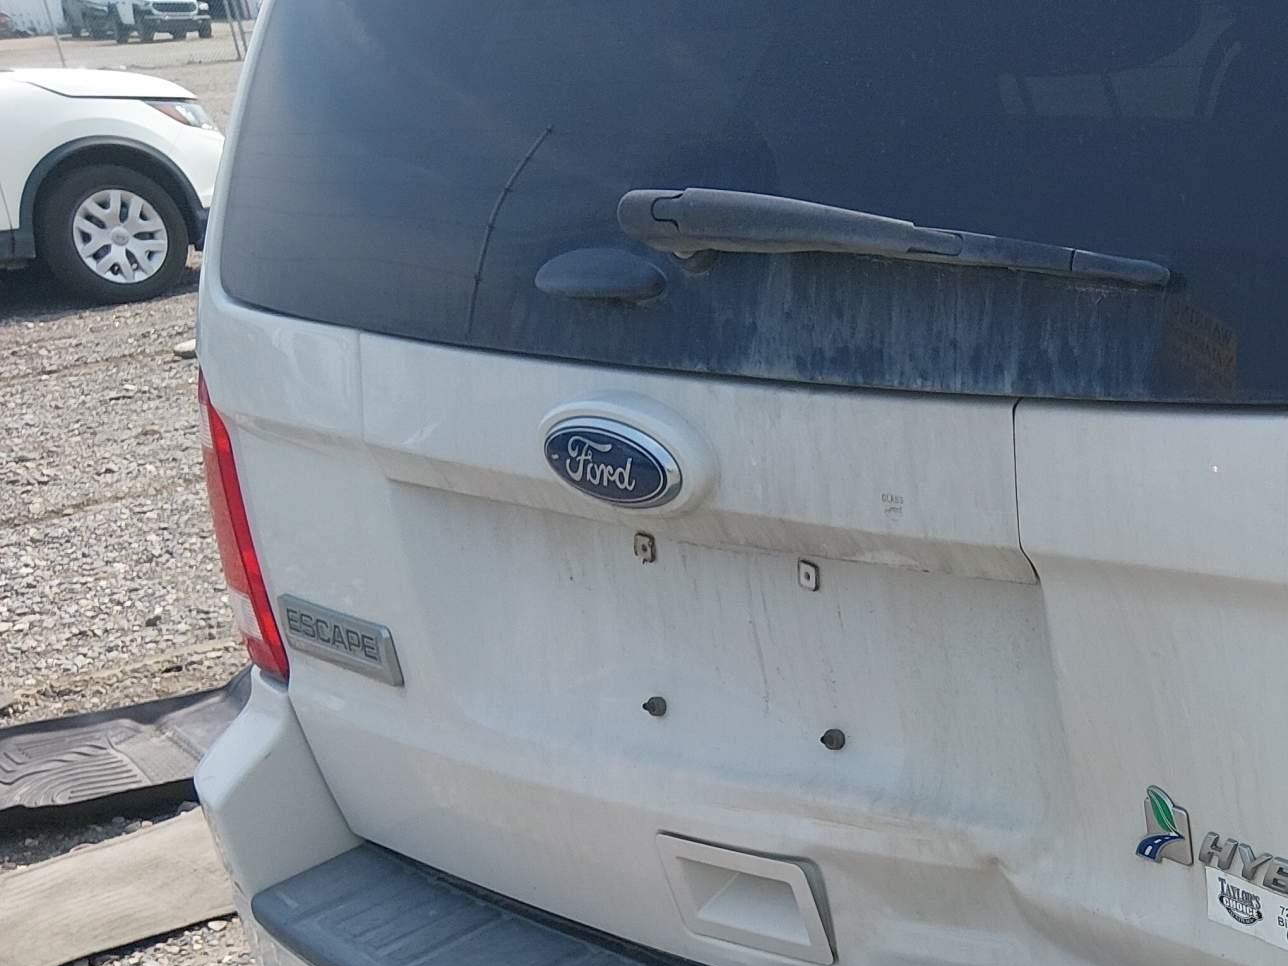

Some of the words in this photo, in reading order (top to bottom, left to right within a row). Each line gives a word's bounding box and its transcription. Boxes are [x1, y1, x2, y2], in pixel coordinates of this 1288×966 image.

[565, 435, 636, 492] Ford
[286, 608, 379, 661] ESCAPE
[1223, 897, 1258, 918] CHOICE
